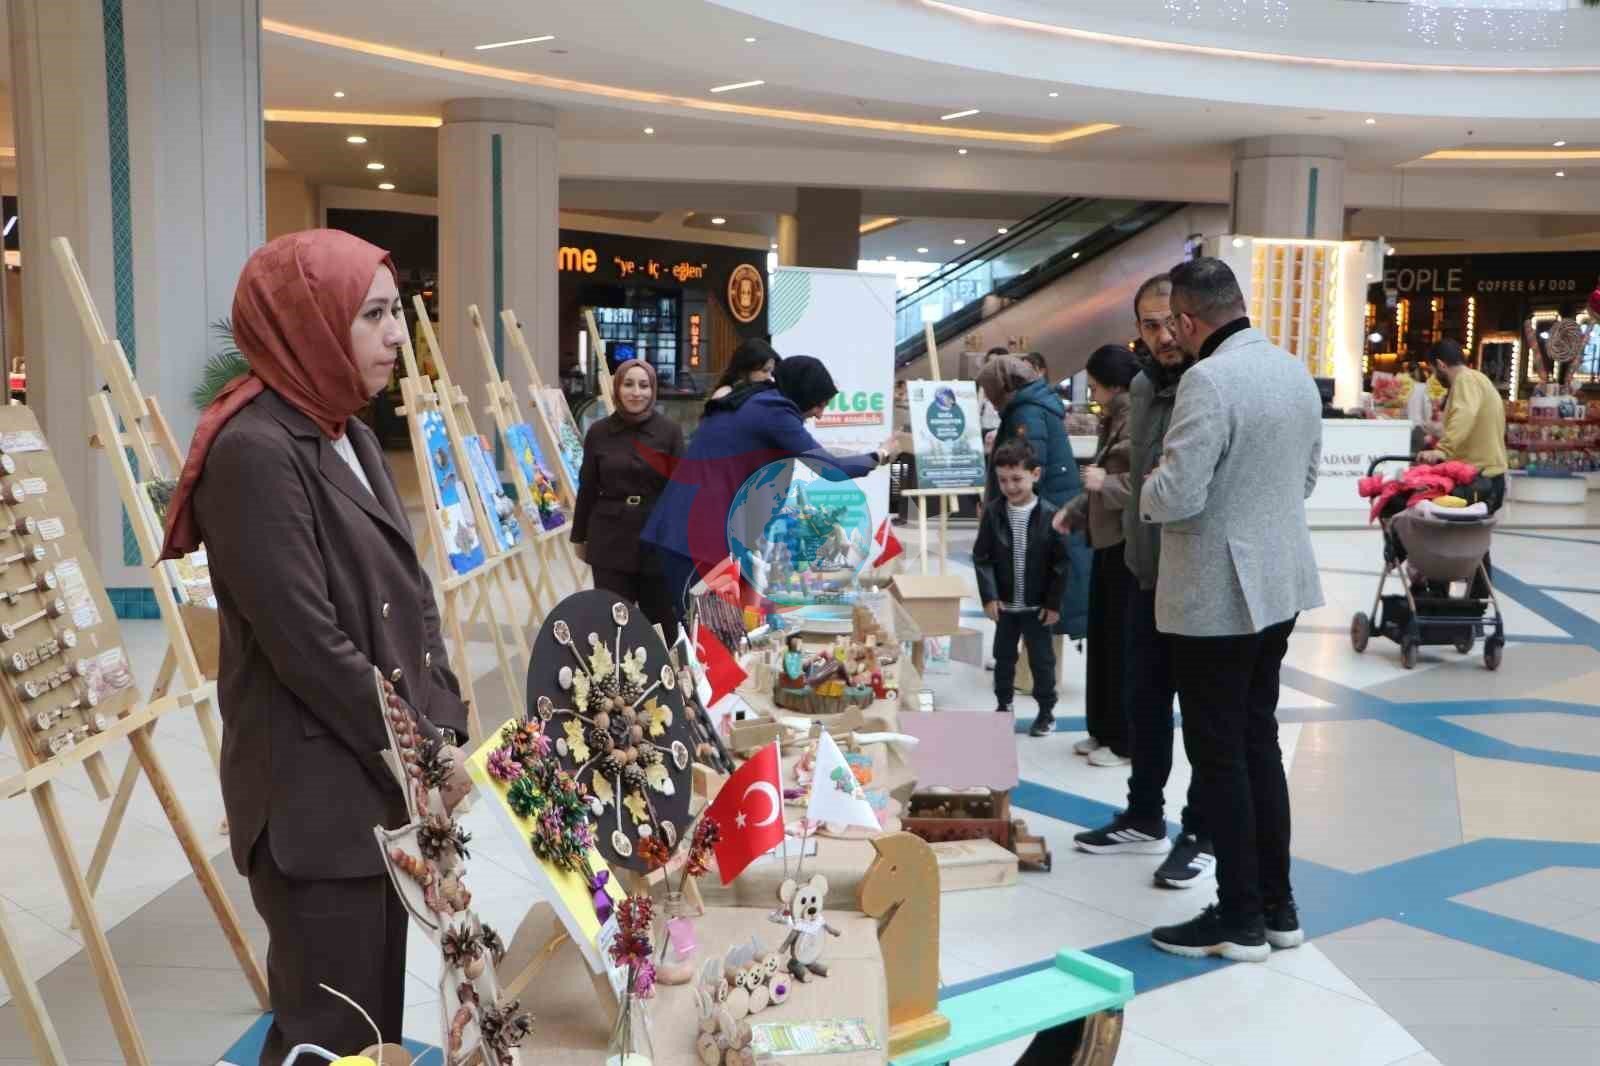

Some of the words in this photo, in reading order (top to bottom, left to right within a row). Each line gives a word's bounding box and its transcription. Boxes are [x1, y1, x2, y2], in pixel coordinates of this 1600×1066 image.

[558, 246, 598, 273] me
[1383, 268, 1463, 292] EOPLE
[1477, 280, 1524, 291] COFFEE
[1527, 280, 1536, 290] &
